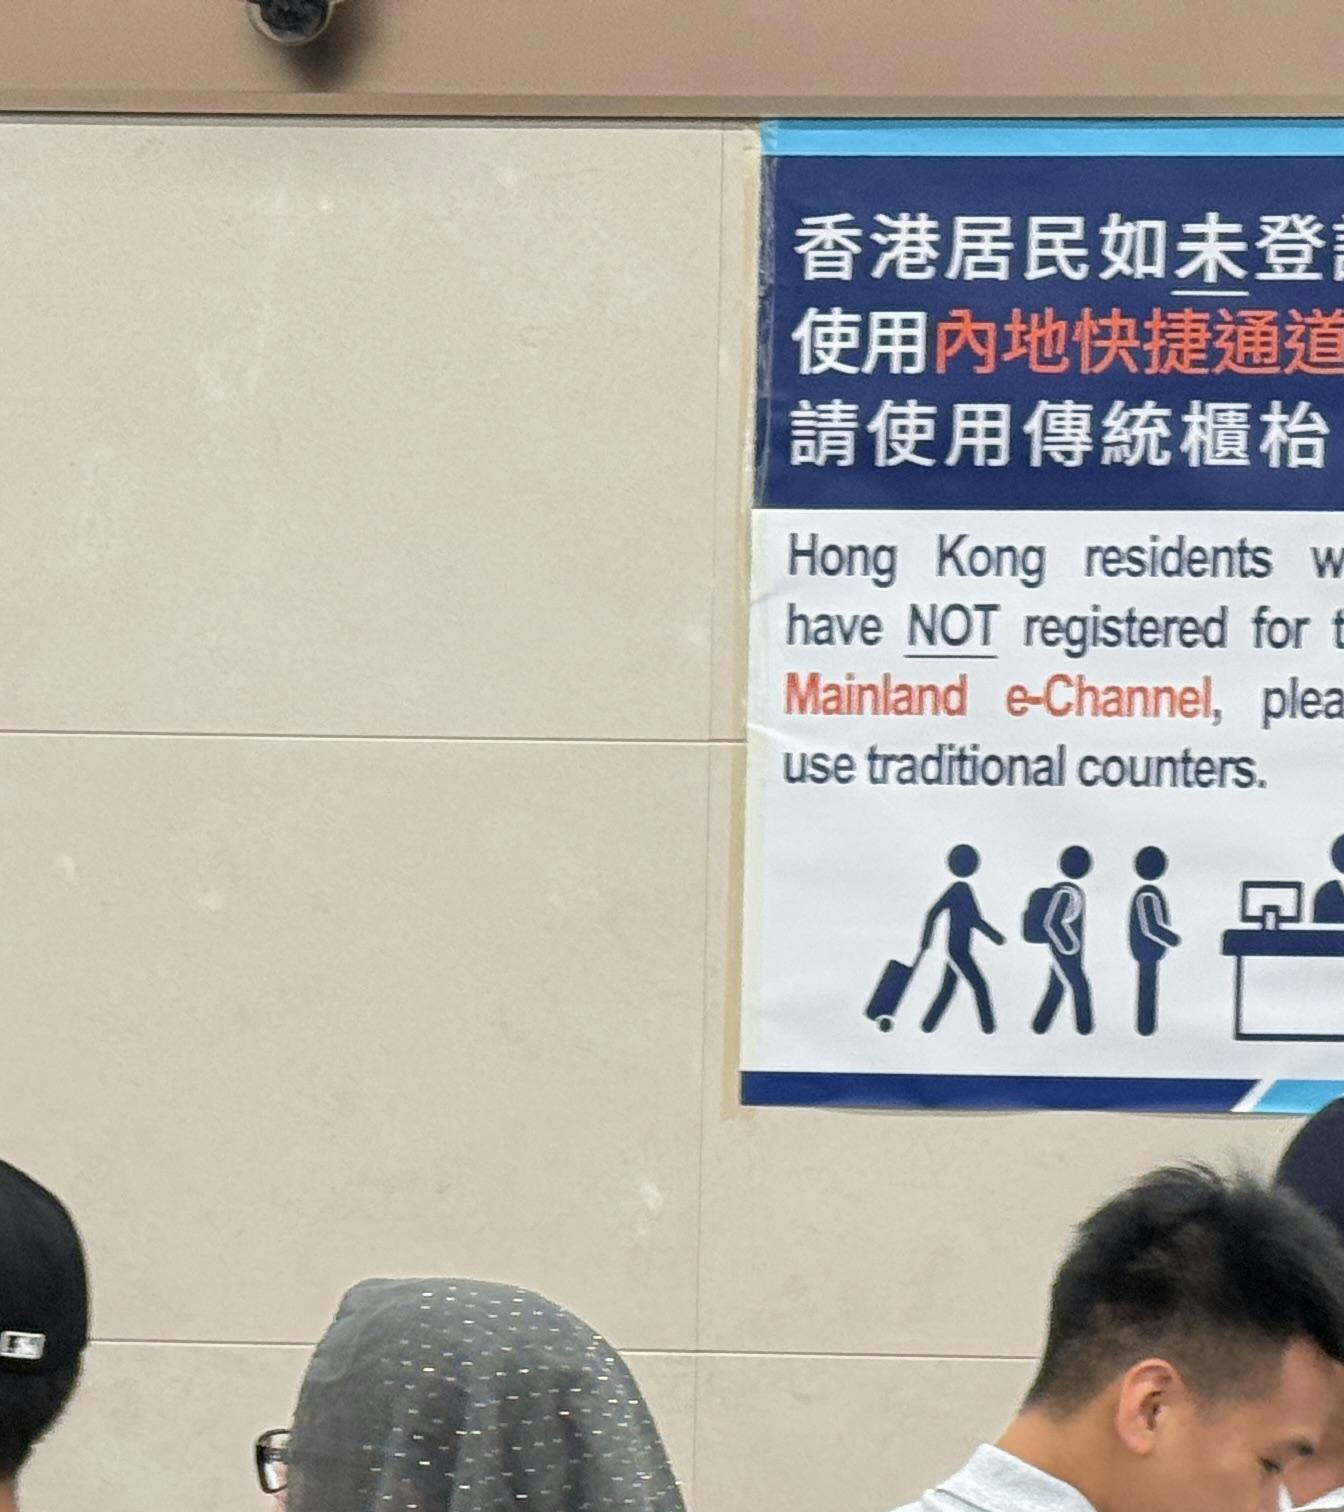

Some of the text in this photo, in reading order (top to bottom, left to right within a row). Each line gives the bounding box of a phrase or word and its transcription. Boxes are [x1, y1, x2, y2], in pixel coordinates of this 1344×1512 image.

[789, 532, 897, 589] Hong
[937, 533, 1046, 588] Kong
[1085, 535, 1273, 579] residents
[786, 603, 882, 647] have
[908, 604, 1000, 647] NOT
[1025, 605, 1228, 658] registered
[1252, 606, 1310, 649] for
[784, 672, 967, 717] Mainland
[1006, 673, 1222, 726] e-Channel,
[783, 743, 1266, 789] use traditional counters.
